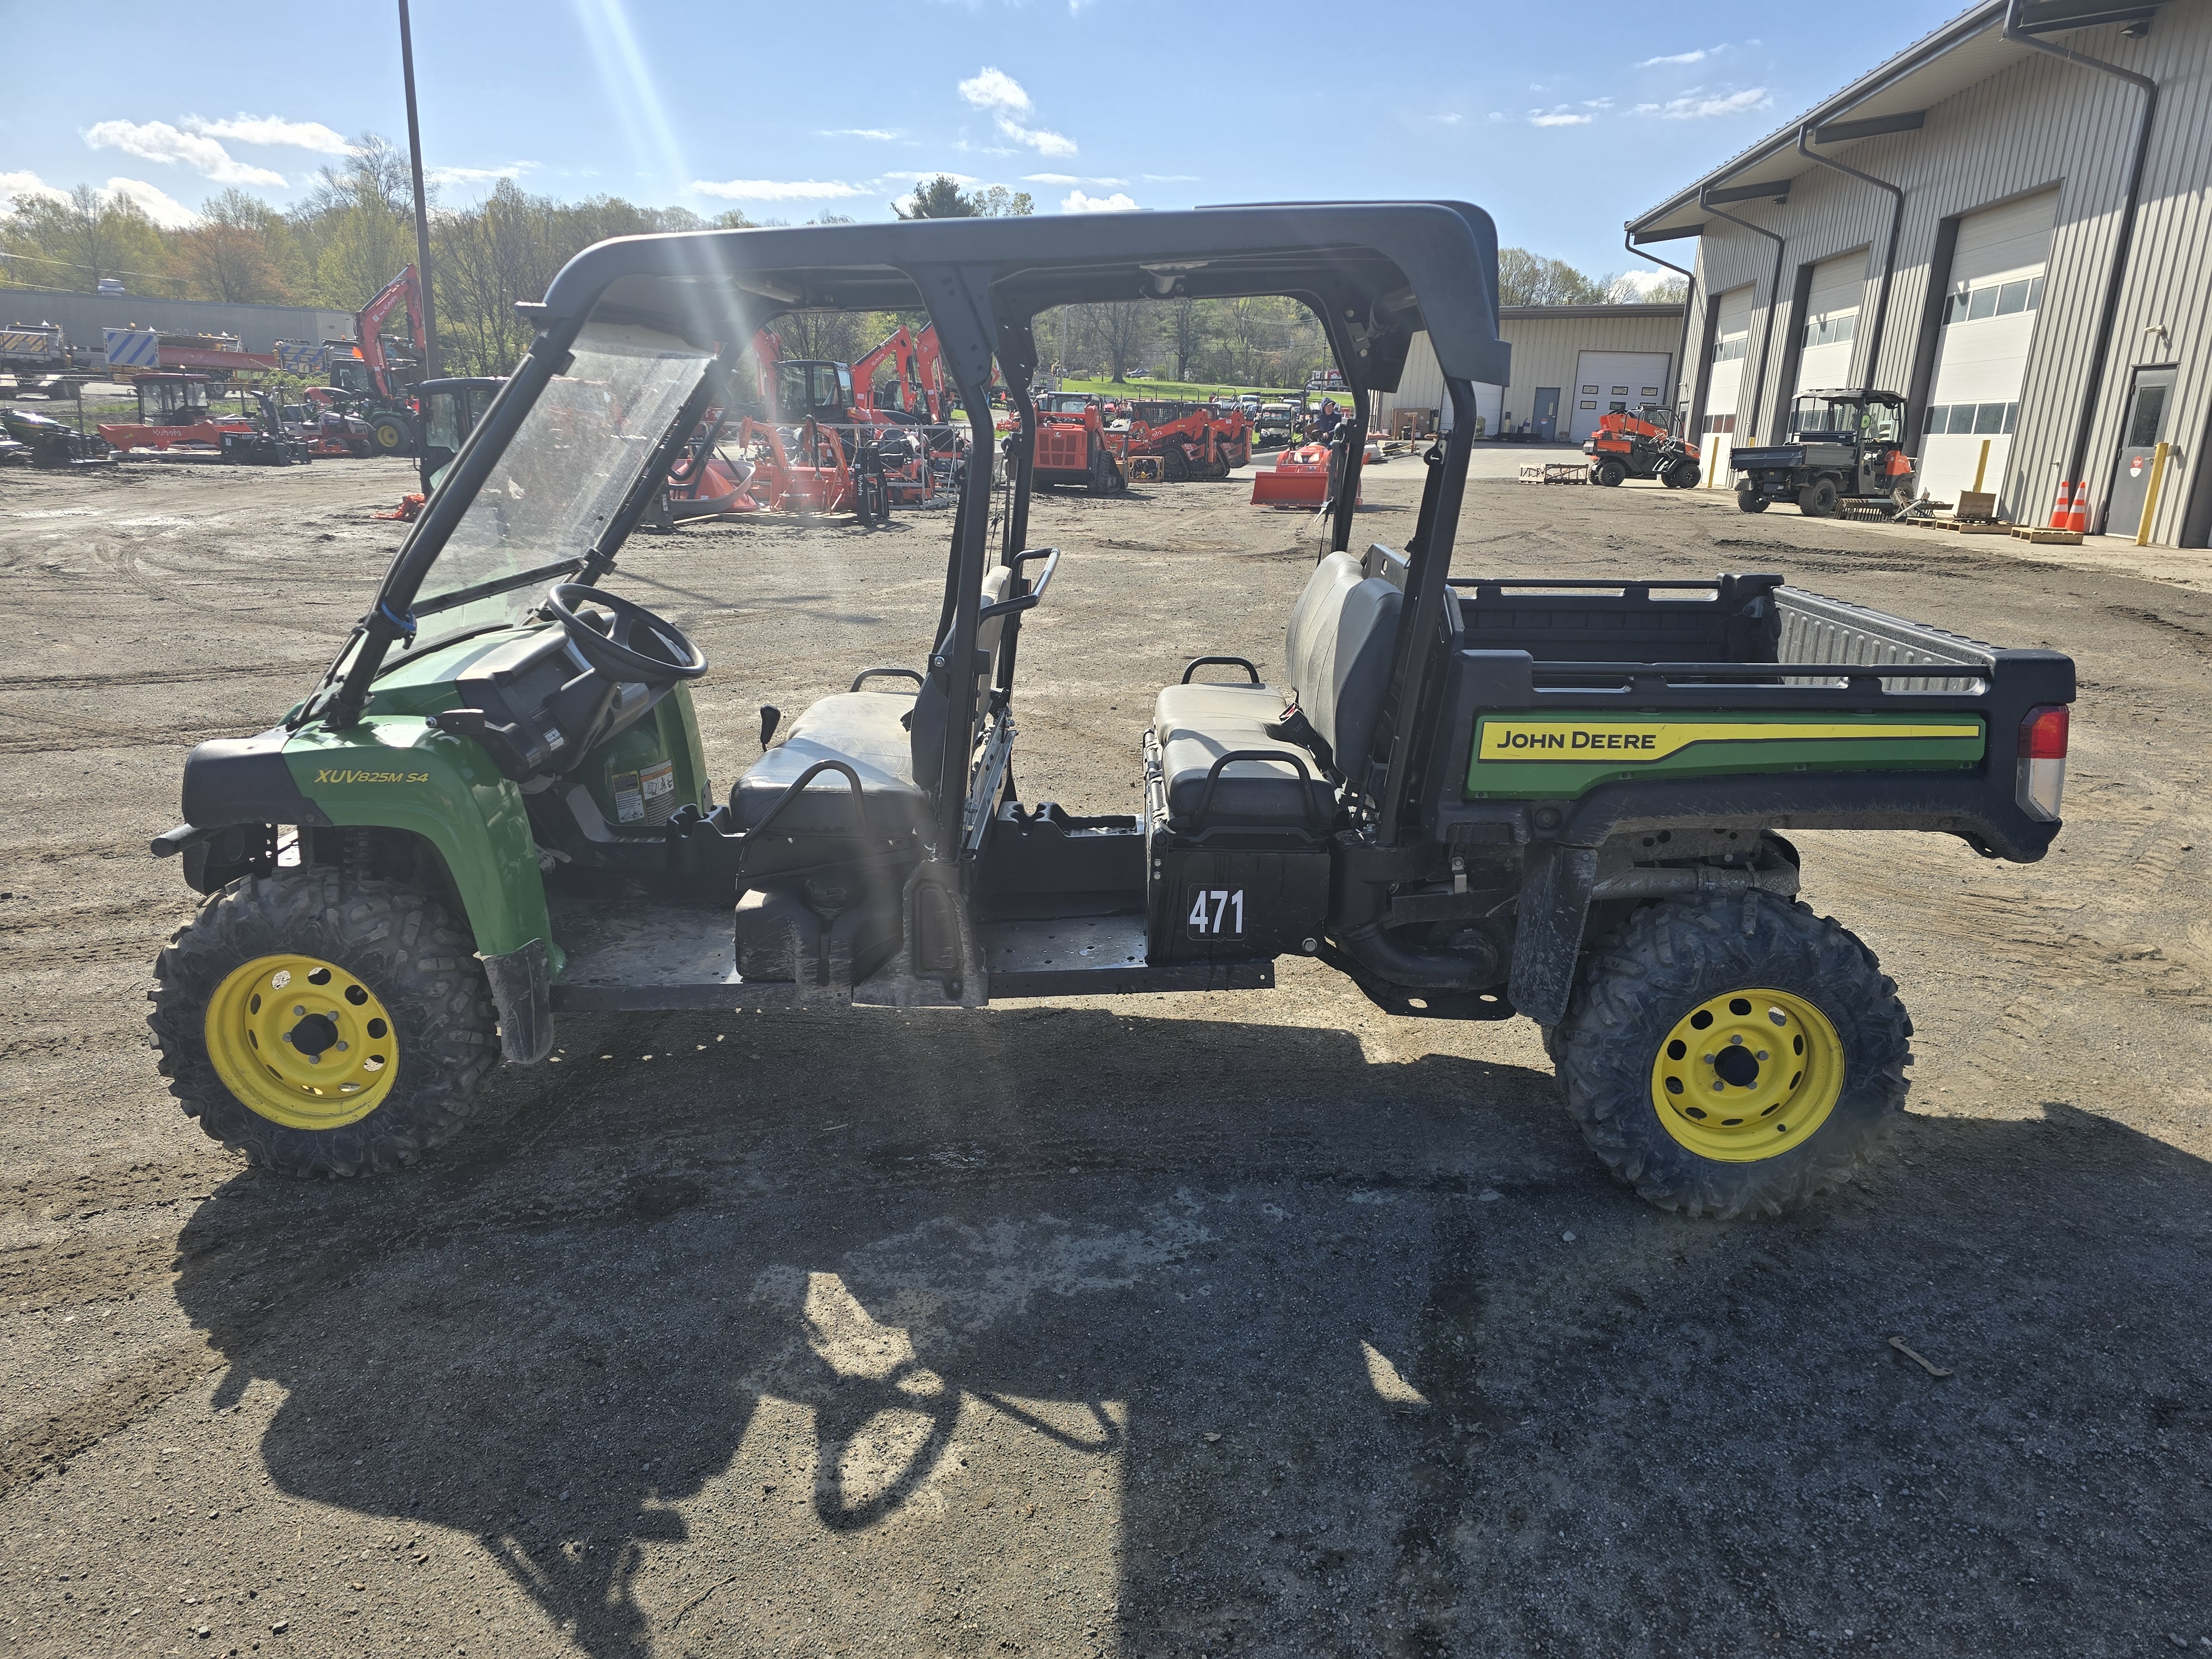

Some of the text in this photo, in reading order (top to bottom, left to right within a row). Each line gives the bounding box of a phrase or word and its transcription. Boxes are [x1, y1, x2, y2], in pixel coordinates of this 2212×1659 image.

[383, 295, 398, 310] Kubota
[870, 353, 885, 366] Kubota
[1497, 731, 1656, 749] JOHN DEERE
[312, 769, 429, 783] XUV825M S4
[1189, 889, 1243, 933] 471
